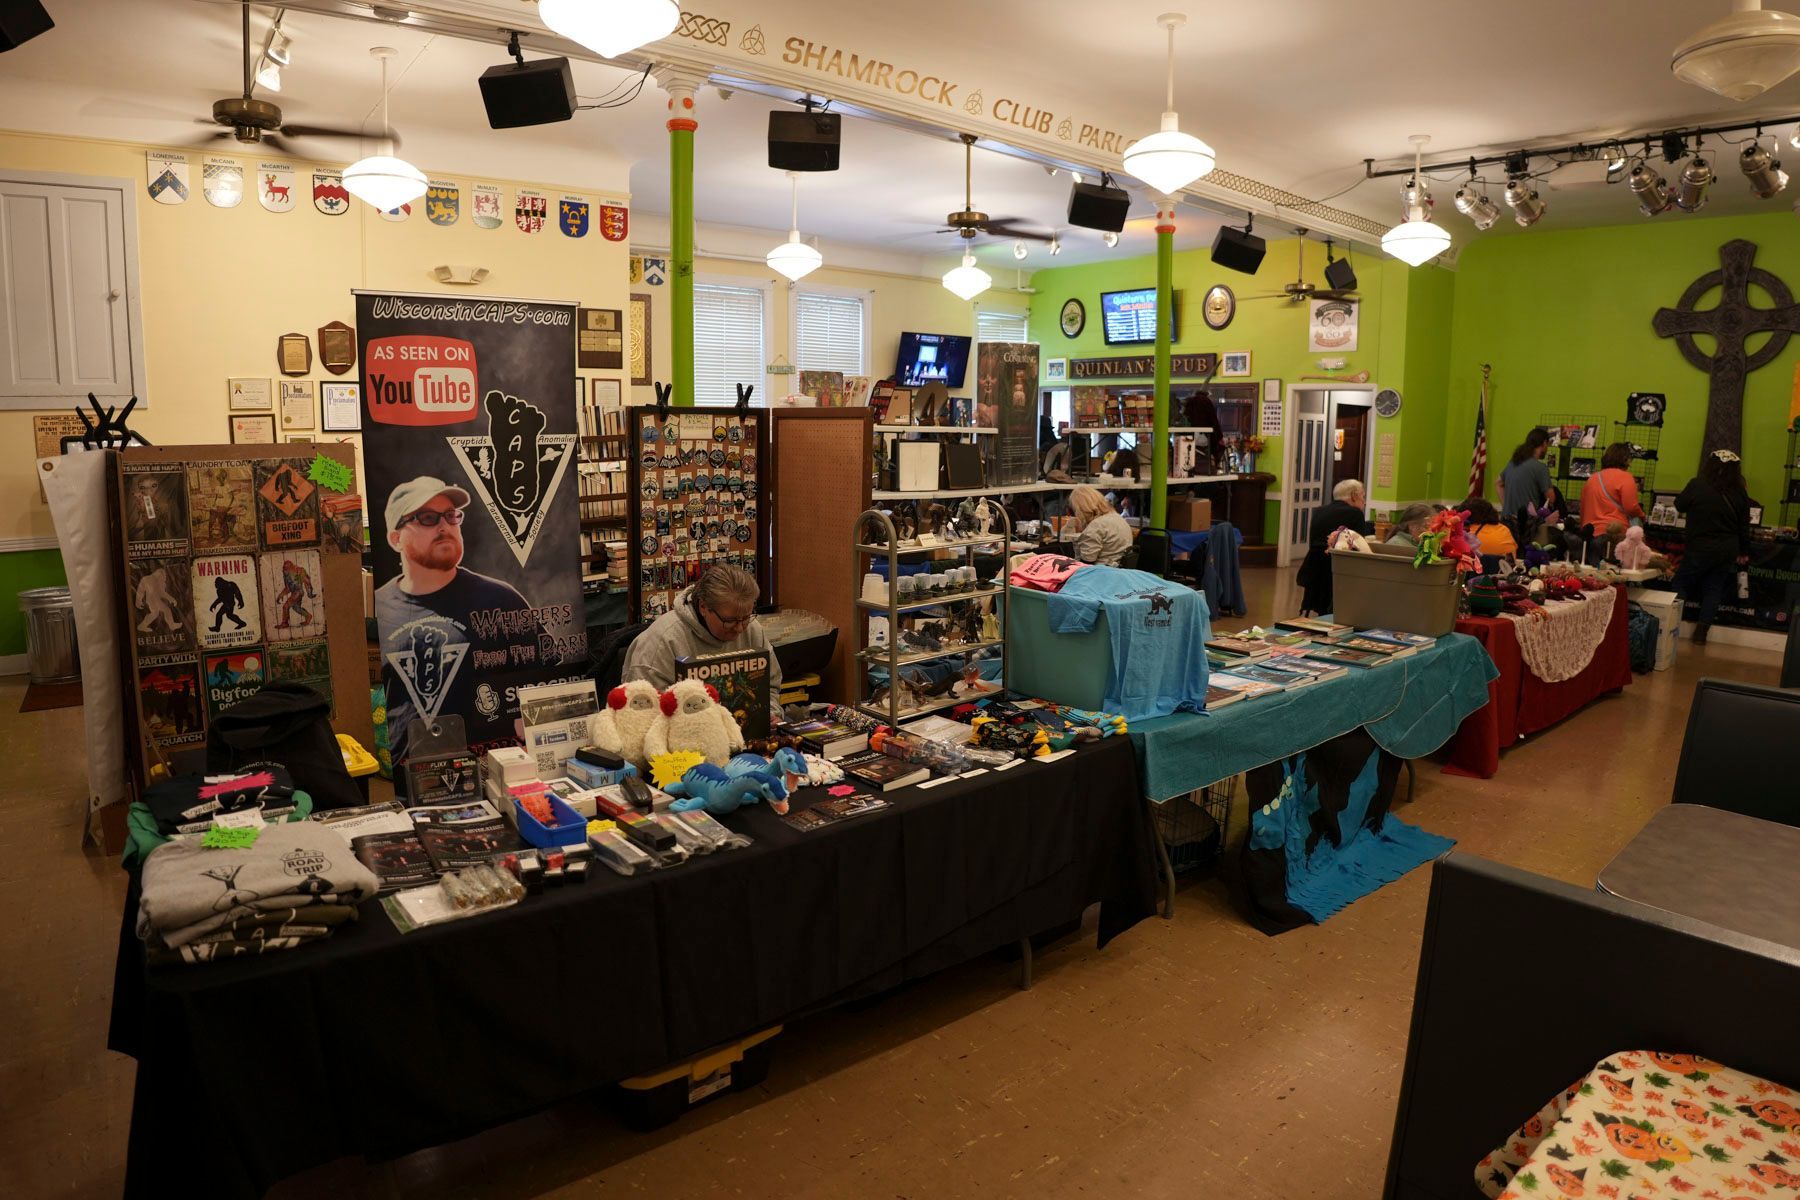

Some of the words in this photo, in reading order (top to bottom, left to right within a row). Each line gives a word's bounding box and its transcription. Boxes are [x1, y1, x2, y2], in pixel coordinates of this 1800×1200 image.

[782, 36, 958, 107] SHAMROCK
[992, 98, 1054, 134] CLUB
[152, 152, 185, 161] LONERGAN
[210, 157, 235, 165] McCANN
[261, 163, 291, 171] McCARTHY
[373, 297, 570, 326] WisconsinCAPS.com
[374, 347, 394, 360] AS
[400, 346, 438, 361] SEEN
[444, 347, 470, 361] ON
[1173, 358, 1208, 373] PUB
[451, 436, 487, 447] Cryptids
[538, 435, 576, 444] Anomalies
[272, 521, 309, 532] BIGFOOT
[487, 501, 517, 545] Paranormal
[529, 510, 544, 540] Society
[281, 531, 302, 541] XING
[134, 542, 174, 551] HUMANS
[470, 604, 572, 640] WHISPERS
[138, 633, 186, 646] BELIEVE
[138, 656, 168, 666] PARTY
[171, 653, 196, 662] WITH
[687, 657, 768, 680] HORRIFIED
[211, 685, 261, 702] Bigfoo
[145, 734, 203, 748] SQUATCH
[287, 857, 324, 868] ROAD
[294, 864, 324, 875] TRIP
